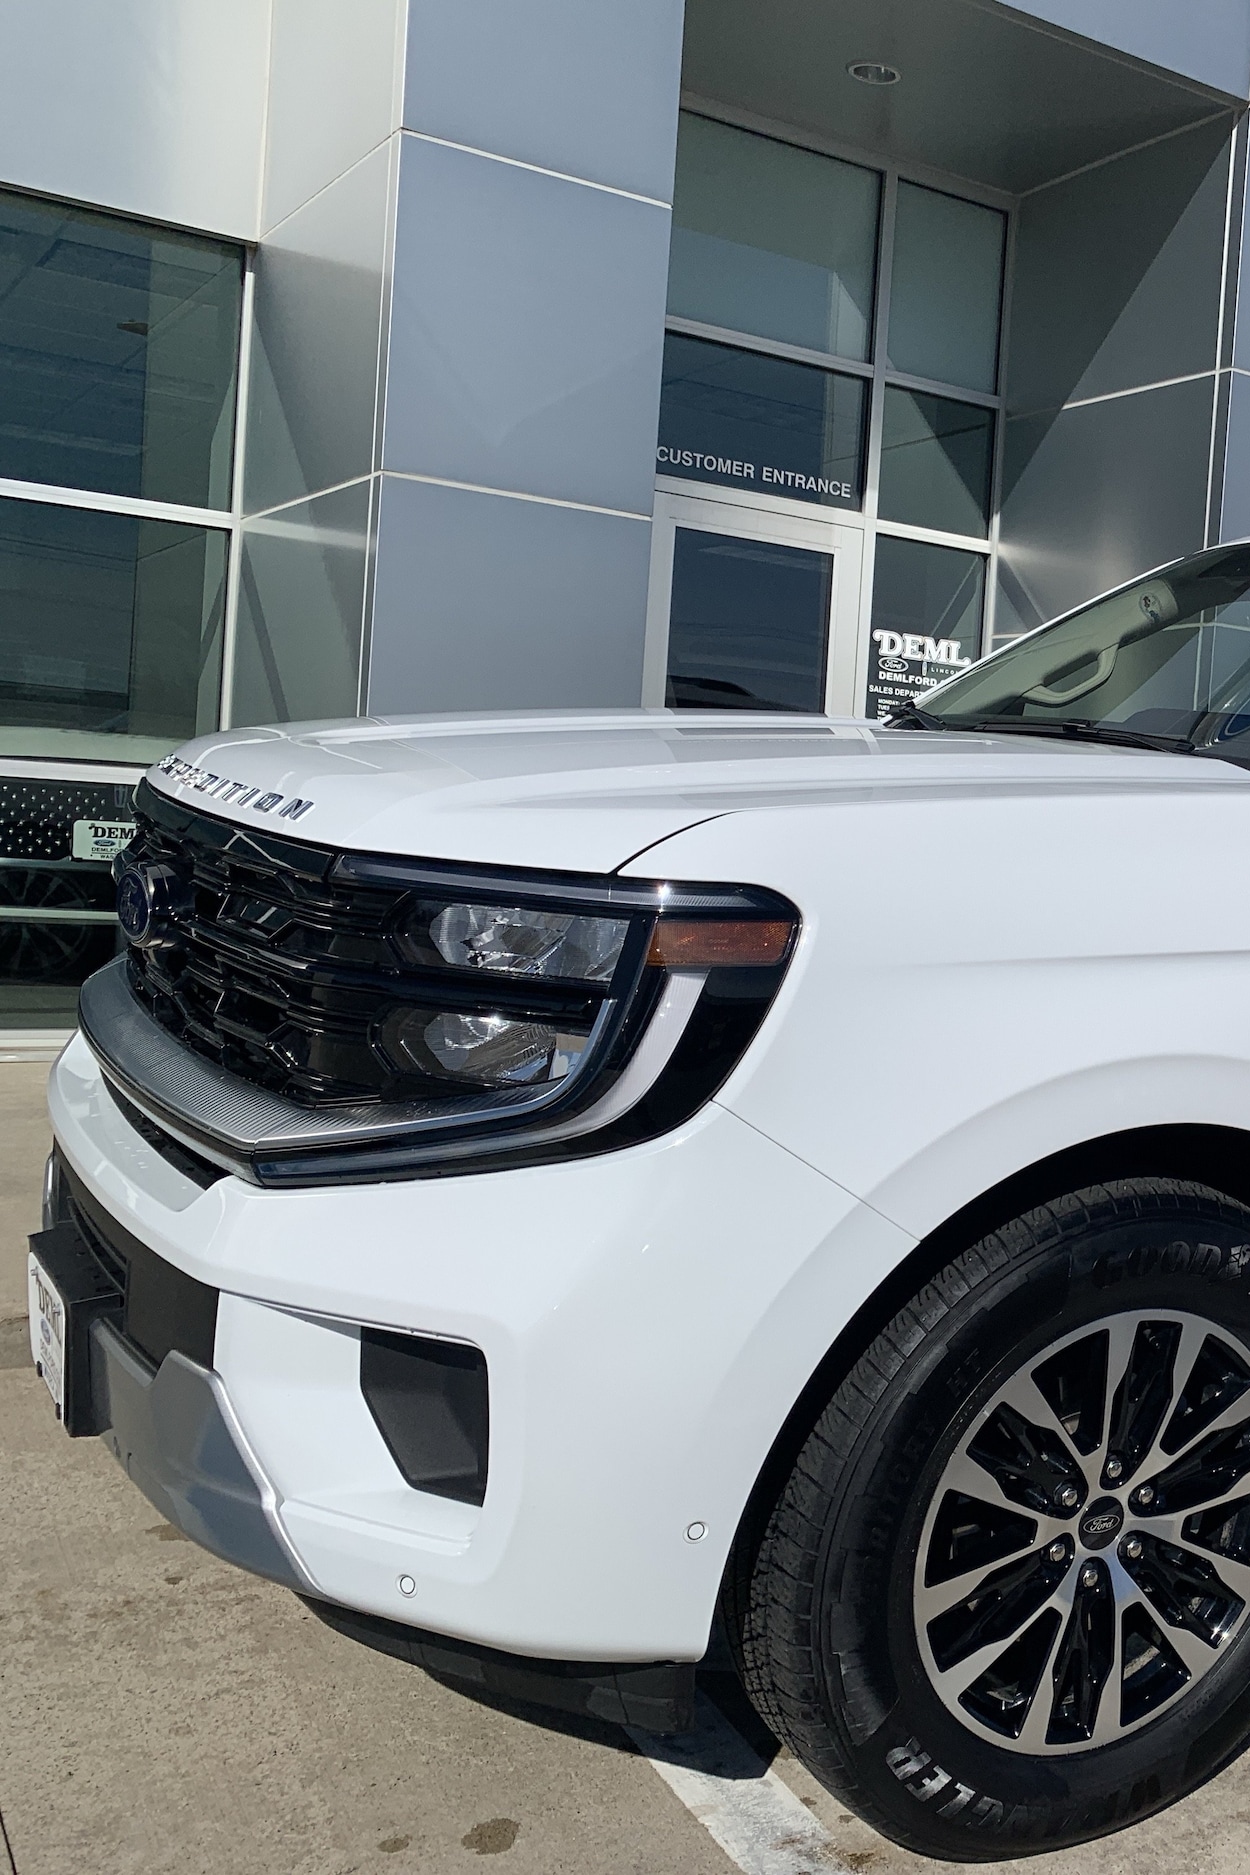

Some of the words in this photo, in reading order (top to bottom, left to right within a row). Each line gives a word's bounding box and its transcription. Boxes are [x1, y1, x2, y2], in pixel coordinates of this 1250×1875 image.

[656, 446, 755, 479] CUSTOMER
[762, 466, 851, 498] ENTRANCE
[873, 629, 972, 668] DEML
[884, 660, 903, 670] Ford
[878, 671, 938, 687] DEMLFORD
[869, 684, 893, 695] SALES
[157, 754, 314, 822] EXPEDITION
[89, 823, 135, 839] DEM
[1090, 1517, 1114, 1532] Ford
